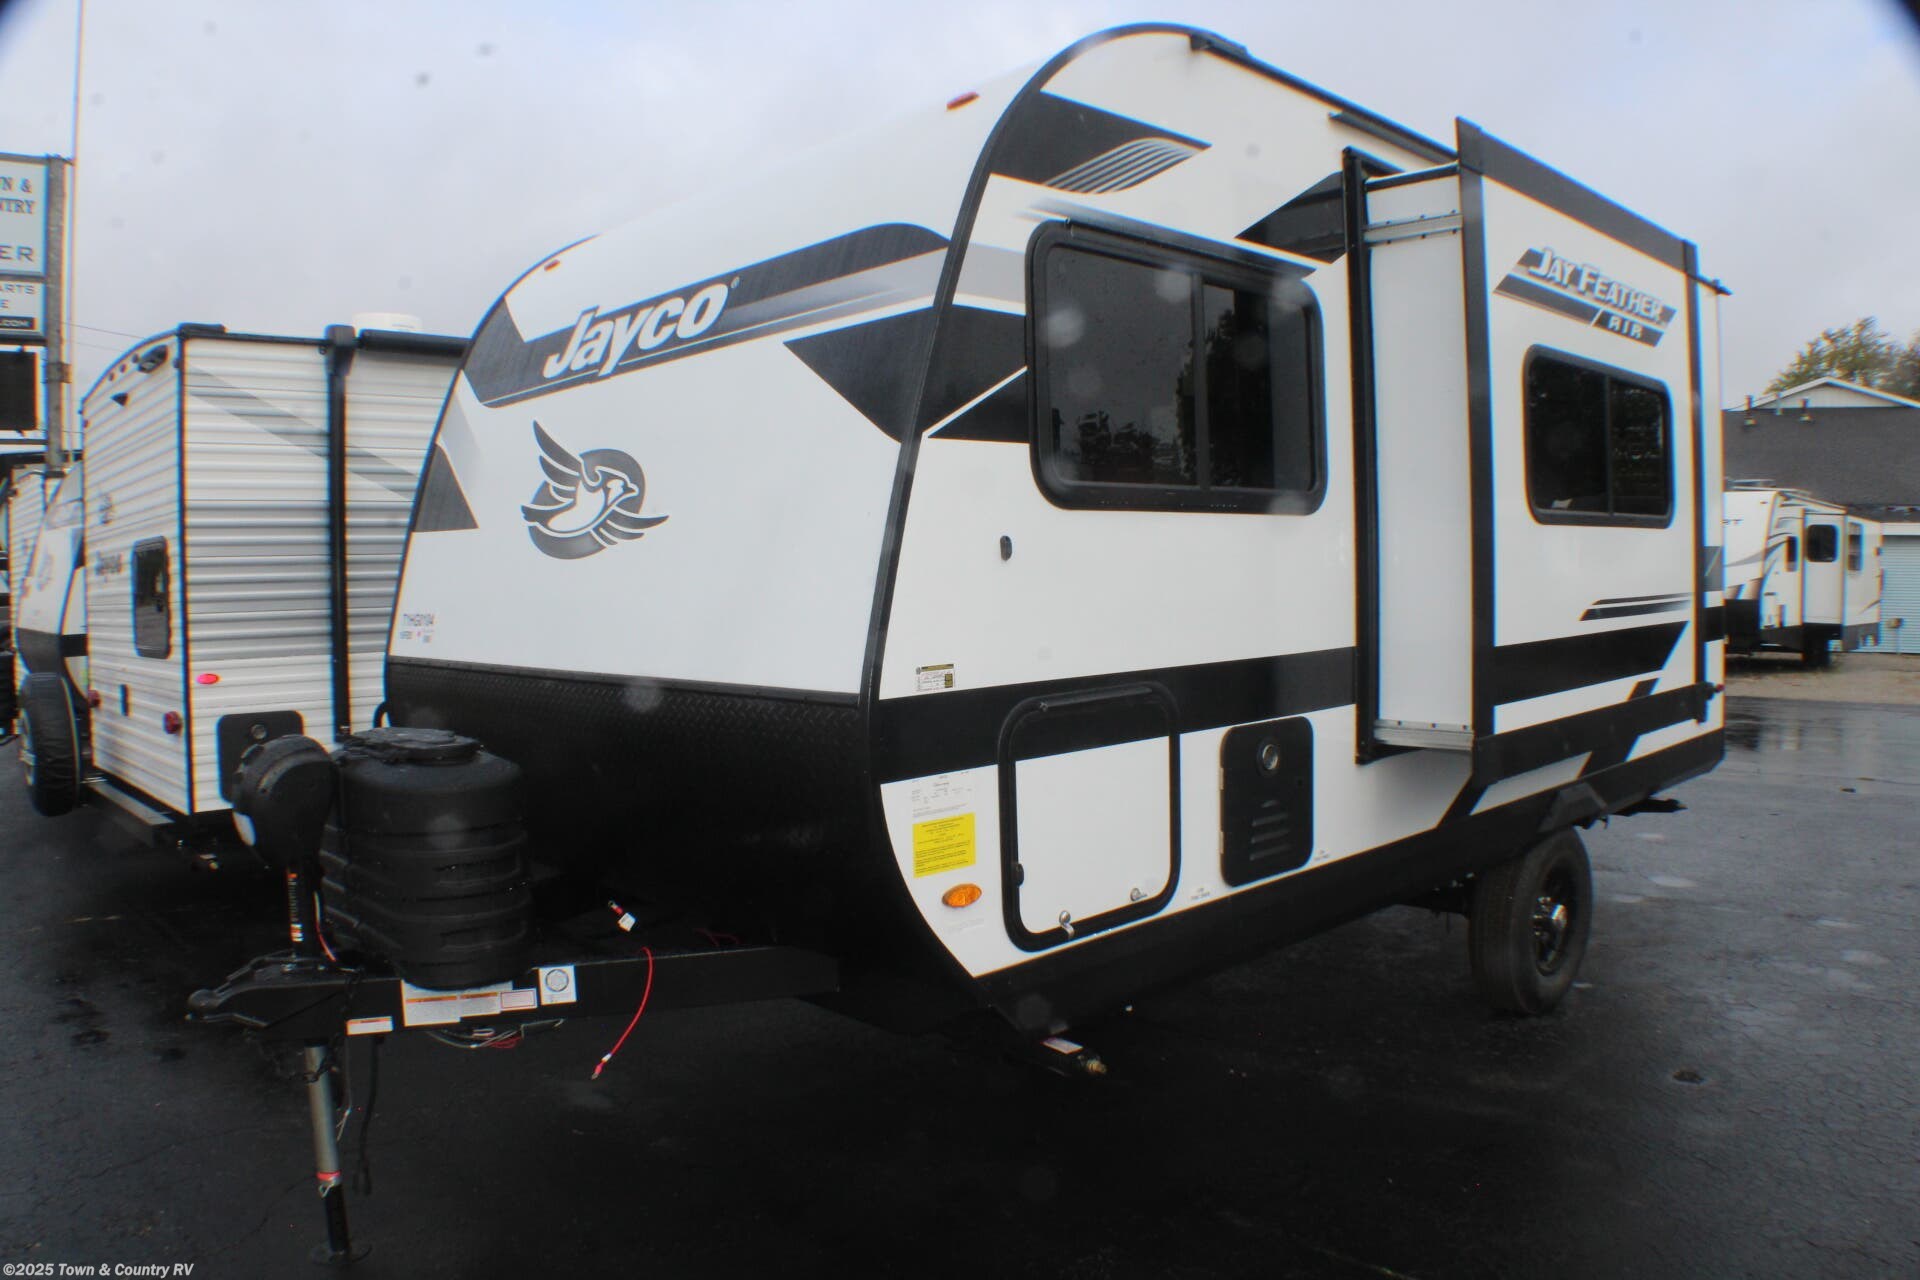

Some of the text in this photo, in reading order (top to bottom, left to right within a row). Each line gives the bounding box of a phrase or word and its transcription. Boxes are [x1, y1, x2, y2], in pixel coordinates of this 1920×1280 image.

[19, 178, 32, 193] &
[0, 245, 34, 262] ER
[1528, 247, 1662, 322] JAY FEATHER
[542, 283, 729, 377] Jayco
[1607, 315, 1644, 340] AIR
